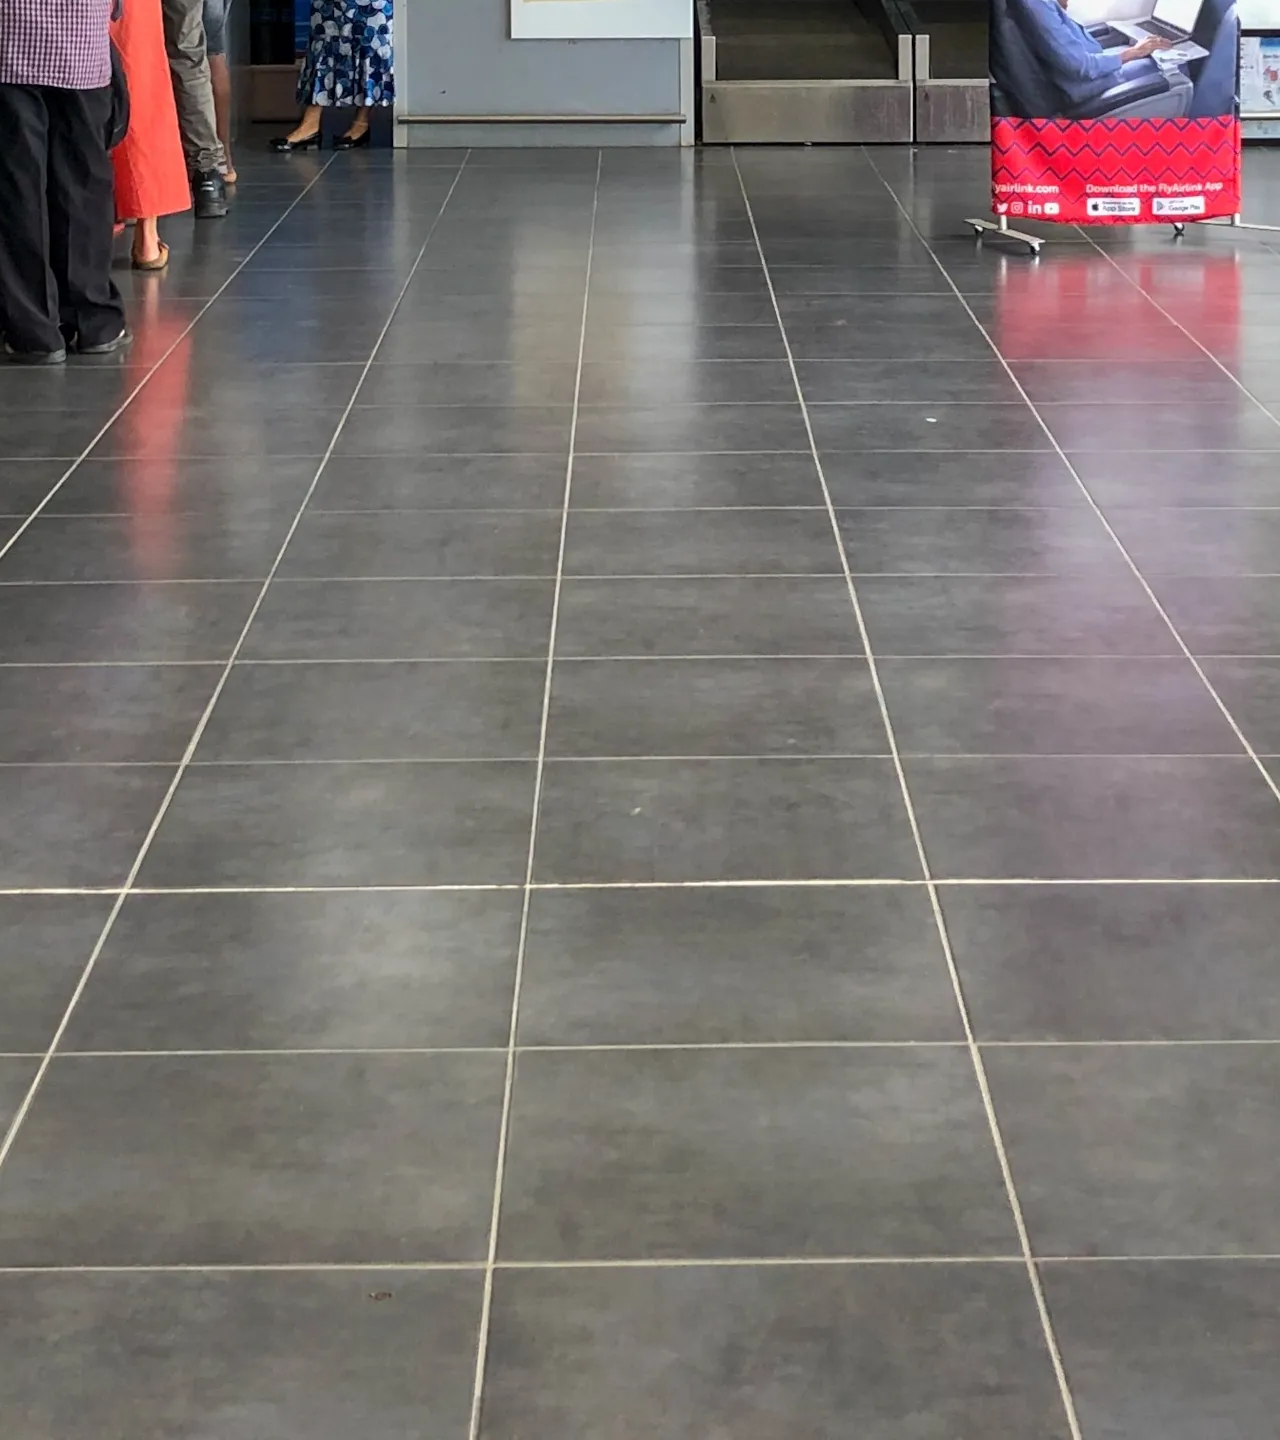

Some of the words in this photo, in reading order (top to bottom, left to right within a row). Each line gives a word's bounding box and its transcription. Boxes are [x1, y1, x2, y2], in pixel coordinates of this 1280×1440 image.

[993, 183, 1059, 194] yairlink.com
[1085, 184, 1137, 193] Download
[1140, 184, 1157, 192] the
[1158, 182, 1203, 194] FlyAirlink
[1205, 182, 1224, 191] App
